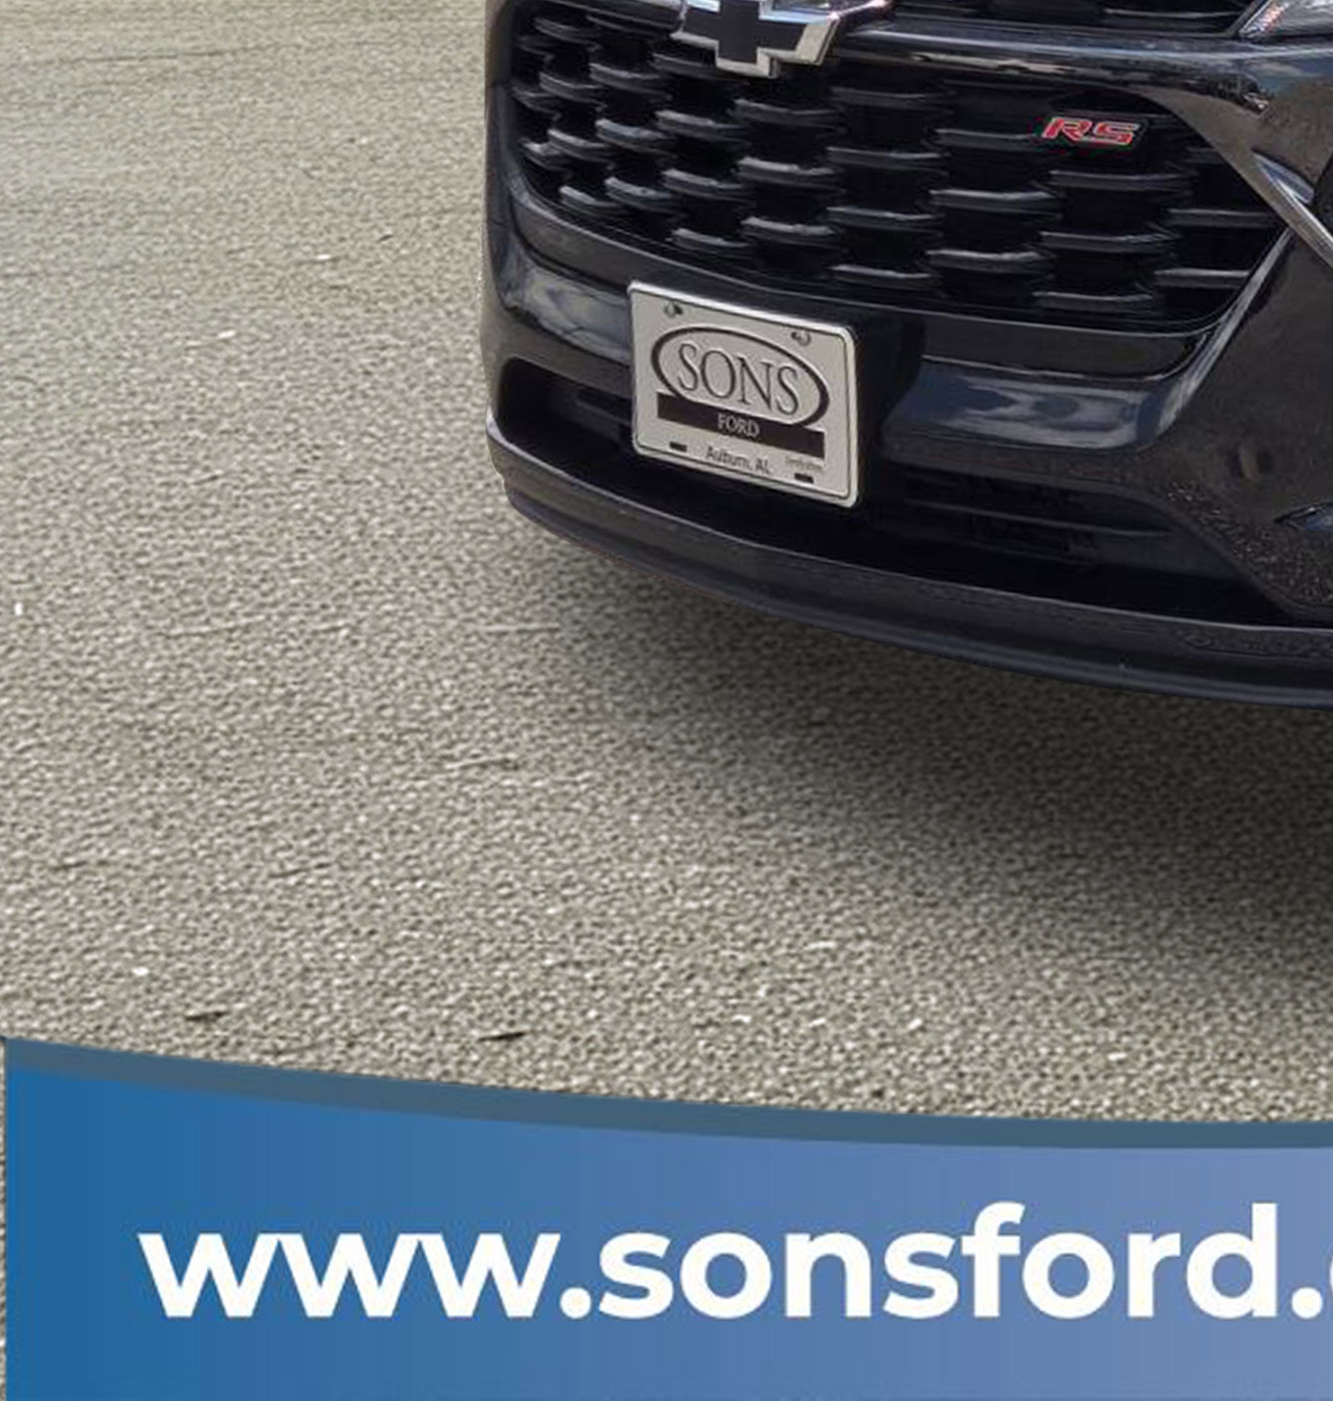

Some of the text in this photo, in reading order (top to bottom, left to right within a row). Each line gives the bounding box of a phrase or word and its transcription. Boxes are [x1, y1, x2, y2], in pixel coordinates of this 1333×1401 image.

[1042, 116, 1140, 146] RS
[676, 342, 801, 416] SONS
[717, 412, 761, 439] FORD
[755, 457, 771, 475] AL
